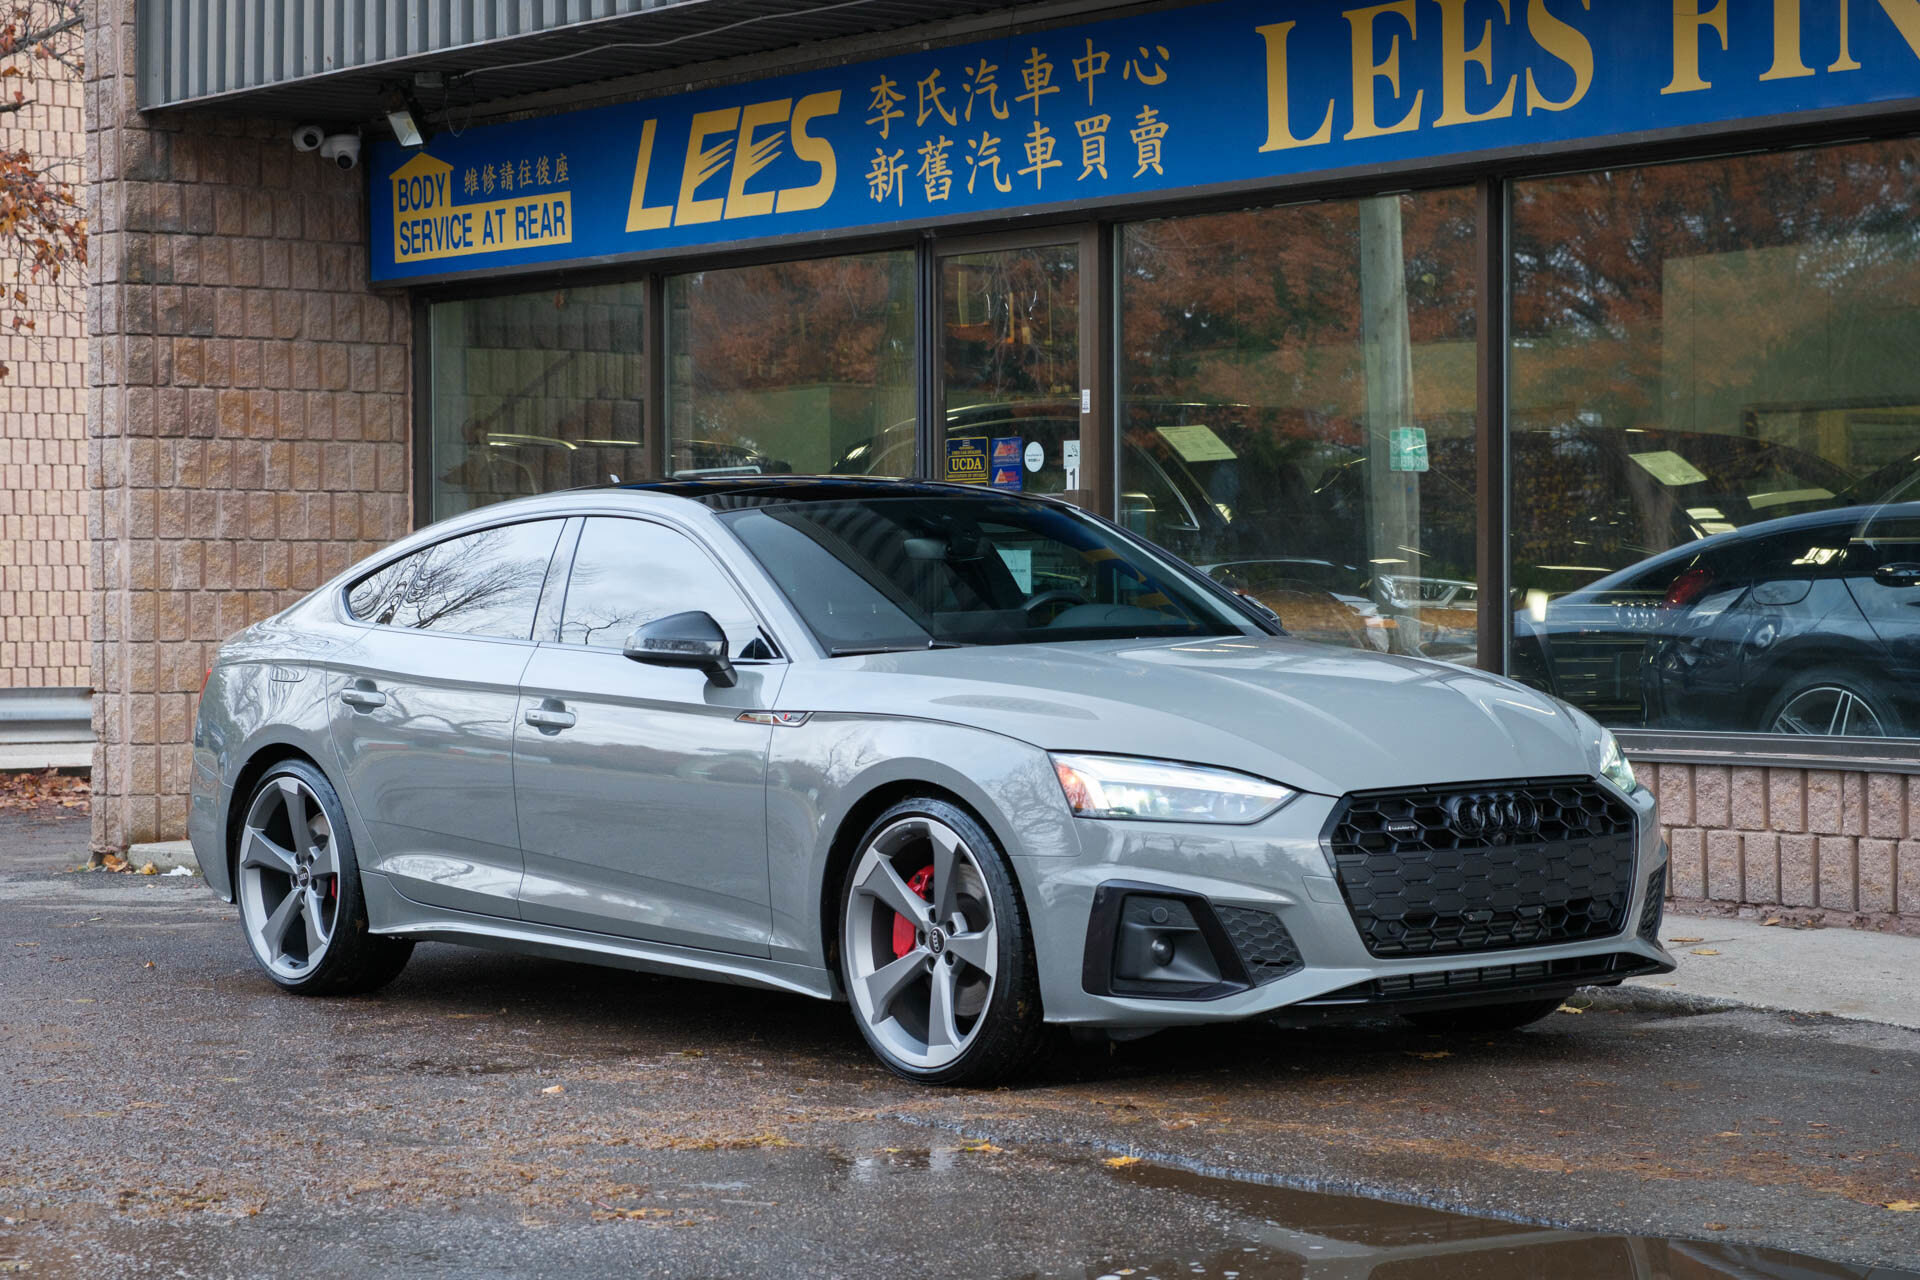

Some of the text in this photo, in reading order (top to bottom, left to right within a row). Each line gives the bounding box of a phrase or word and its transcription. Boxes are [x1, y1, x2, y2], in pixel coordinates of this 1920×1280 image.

[865, 38, 1170, 140] 李氏汽車中心
[1255, 0, 1594, 153] LEES
[398, 173, 446, 212] BODY
[464, 153, 569, 196] 維修請往後座
[625, 89, 842, 232] LEES
[865, 104, 1169, 207] 新舊汽車買賣
[400, 200, 566, 255] SERVICE AT REAR
[951, 457, 982, 471] UCDA
